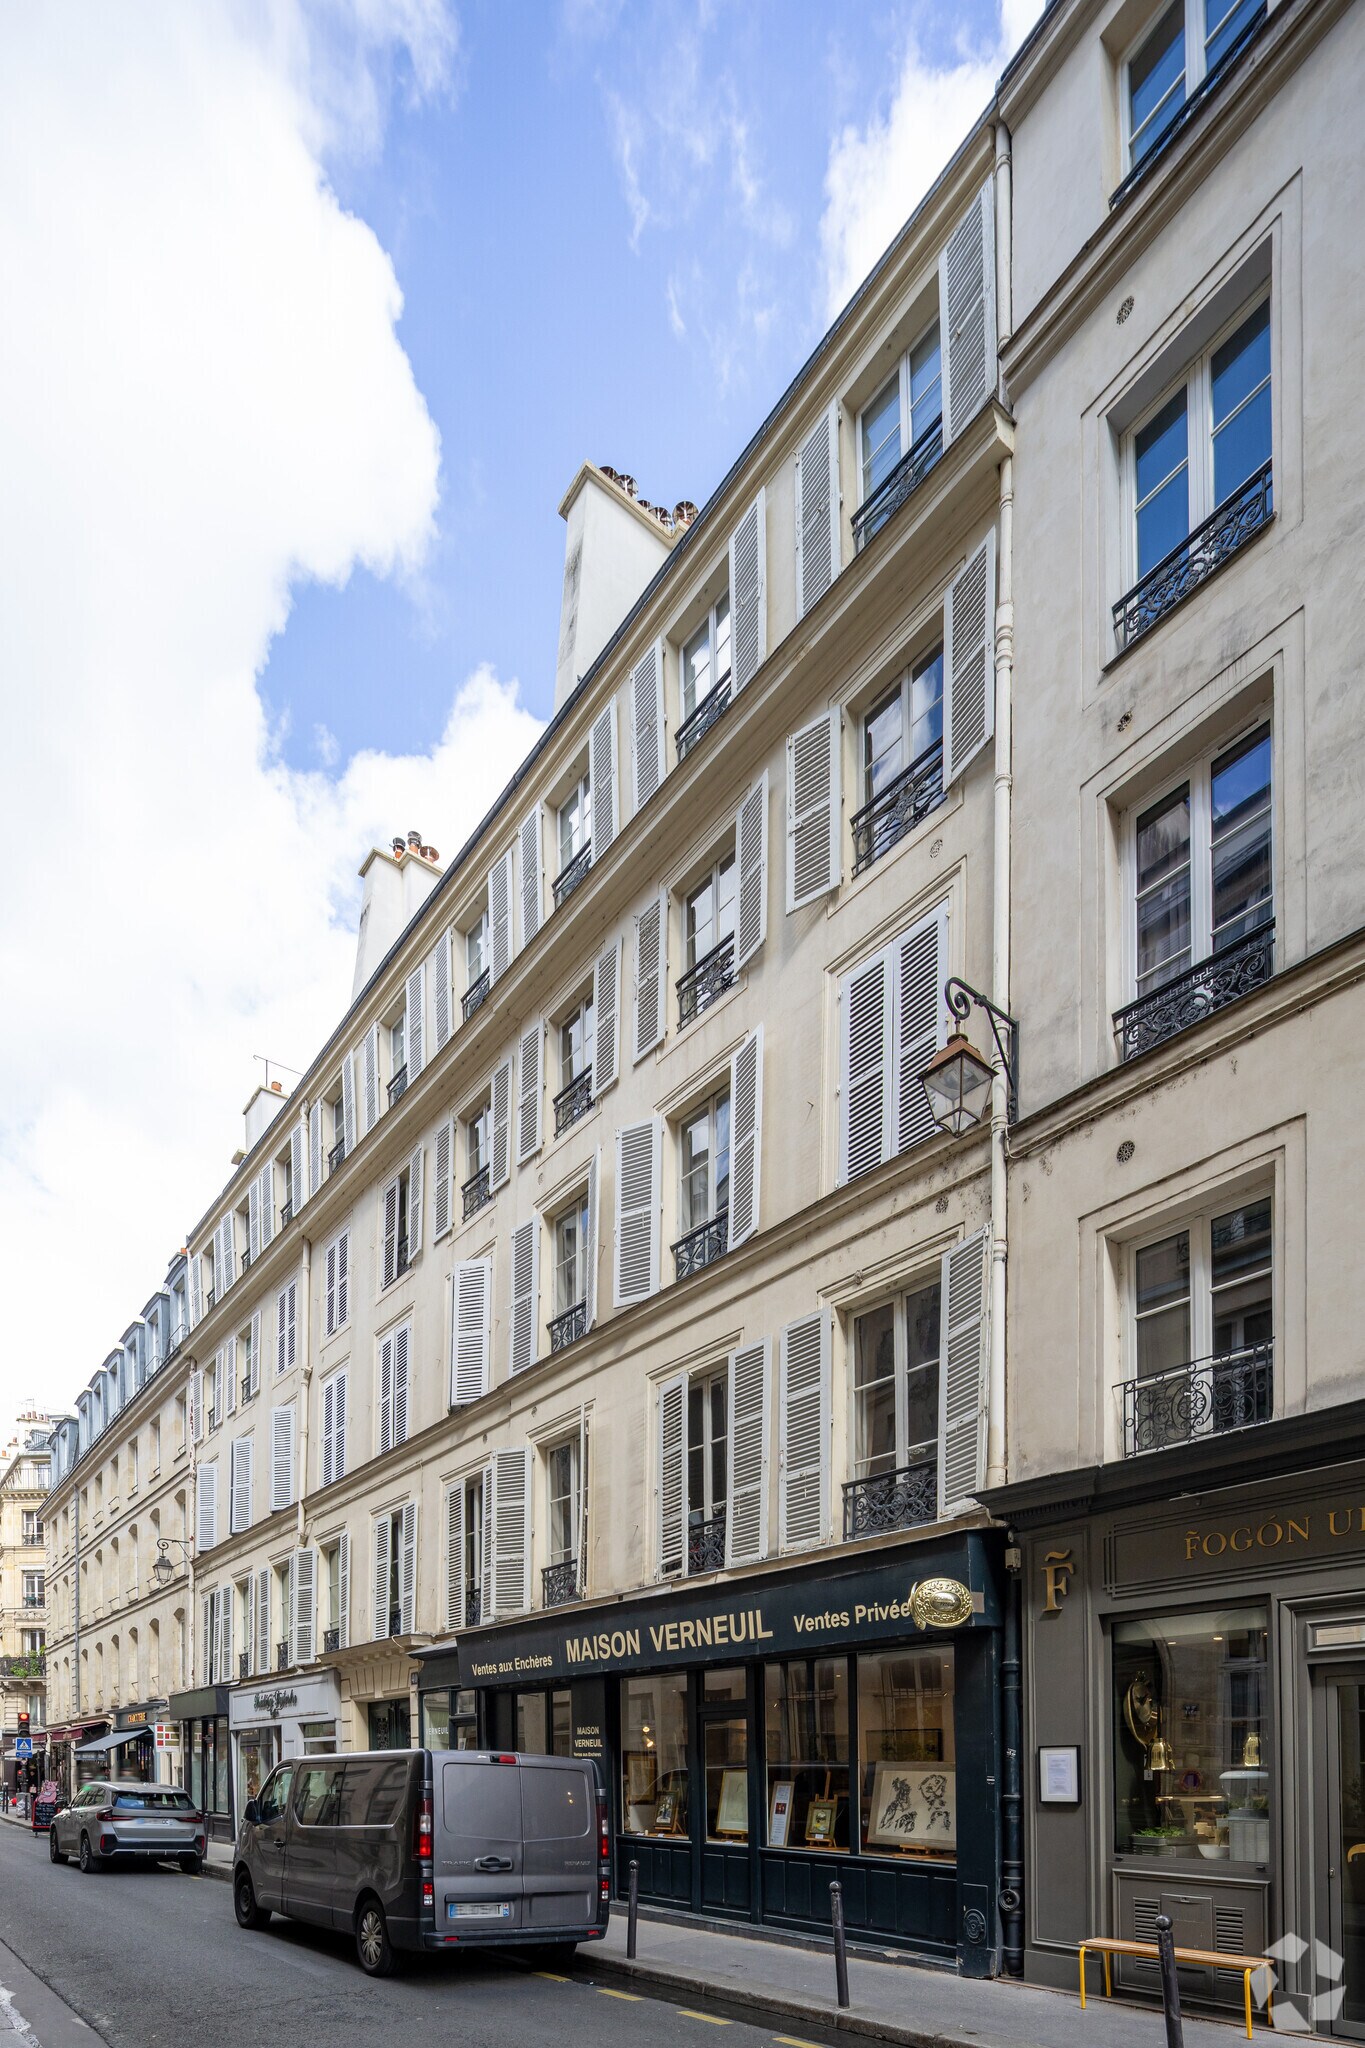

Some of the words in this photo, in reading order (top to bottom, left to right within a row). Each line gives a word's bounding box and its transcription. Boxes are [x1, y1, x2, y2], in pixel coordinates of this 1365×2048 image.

[793, 1611, 850, 1633] Ventes
[855, 1599, 911, 1624] Privée
[566, 1629, 641, 1663] MAISON
[649, 1609, 774, 1652] VERNEUIL
[472, 1663, 497, 1676] Ventes
[499, 1661, 513, 1673] aux
[515, 1654, 553, 1671] Enchères
[576, 1726, 600, 1735] MAISON
[574, 1739, 603, 1748] VERNEUIL
